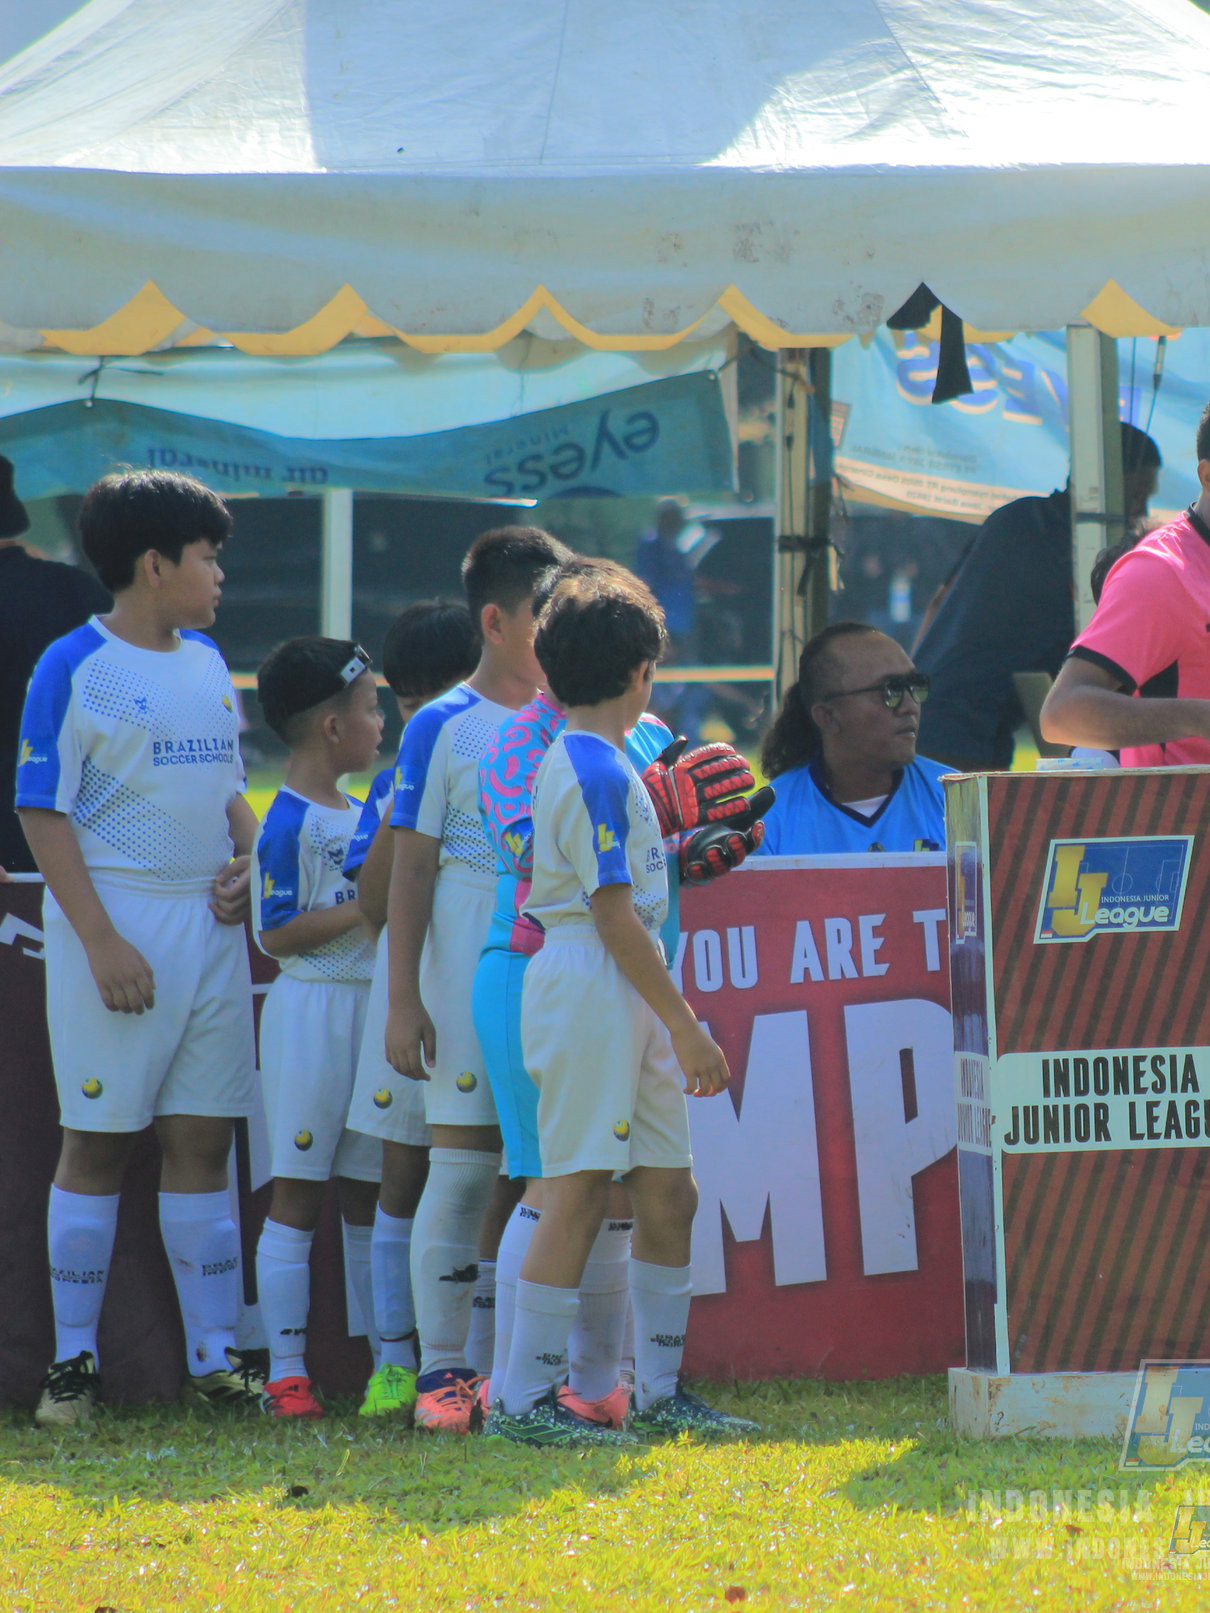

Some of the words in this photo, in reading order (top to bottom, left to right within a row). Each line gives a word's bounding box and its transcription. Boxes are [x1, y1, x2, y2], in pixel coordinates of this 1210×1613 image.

[153, 738, 234, 755] BRAZILIAN
[153, 755, 198, 767] SOCCER
[199, 753, 234, 764] SCHOOLS
[1101, 895, 1141, 904] INDONESIA
[1142, 894, 1170, 902] JUNIOR
[1080, 902, 1170, 930] League
[790, 913, 890, 985] ARE
[1042, 1054, 1200, 1098] INDONESIA
[1004, 1102, 1112, 1146] JUNIOR
